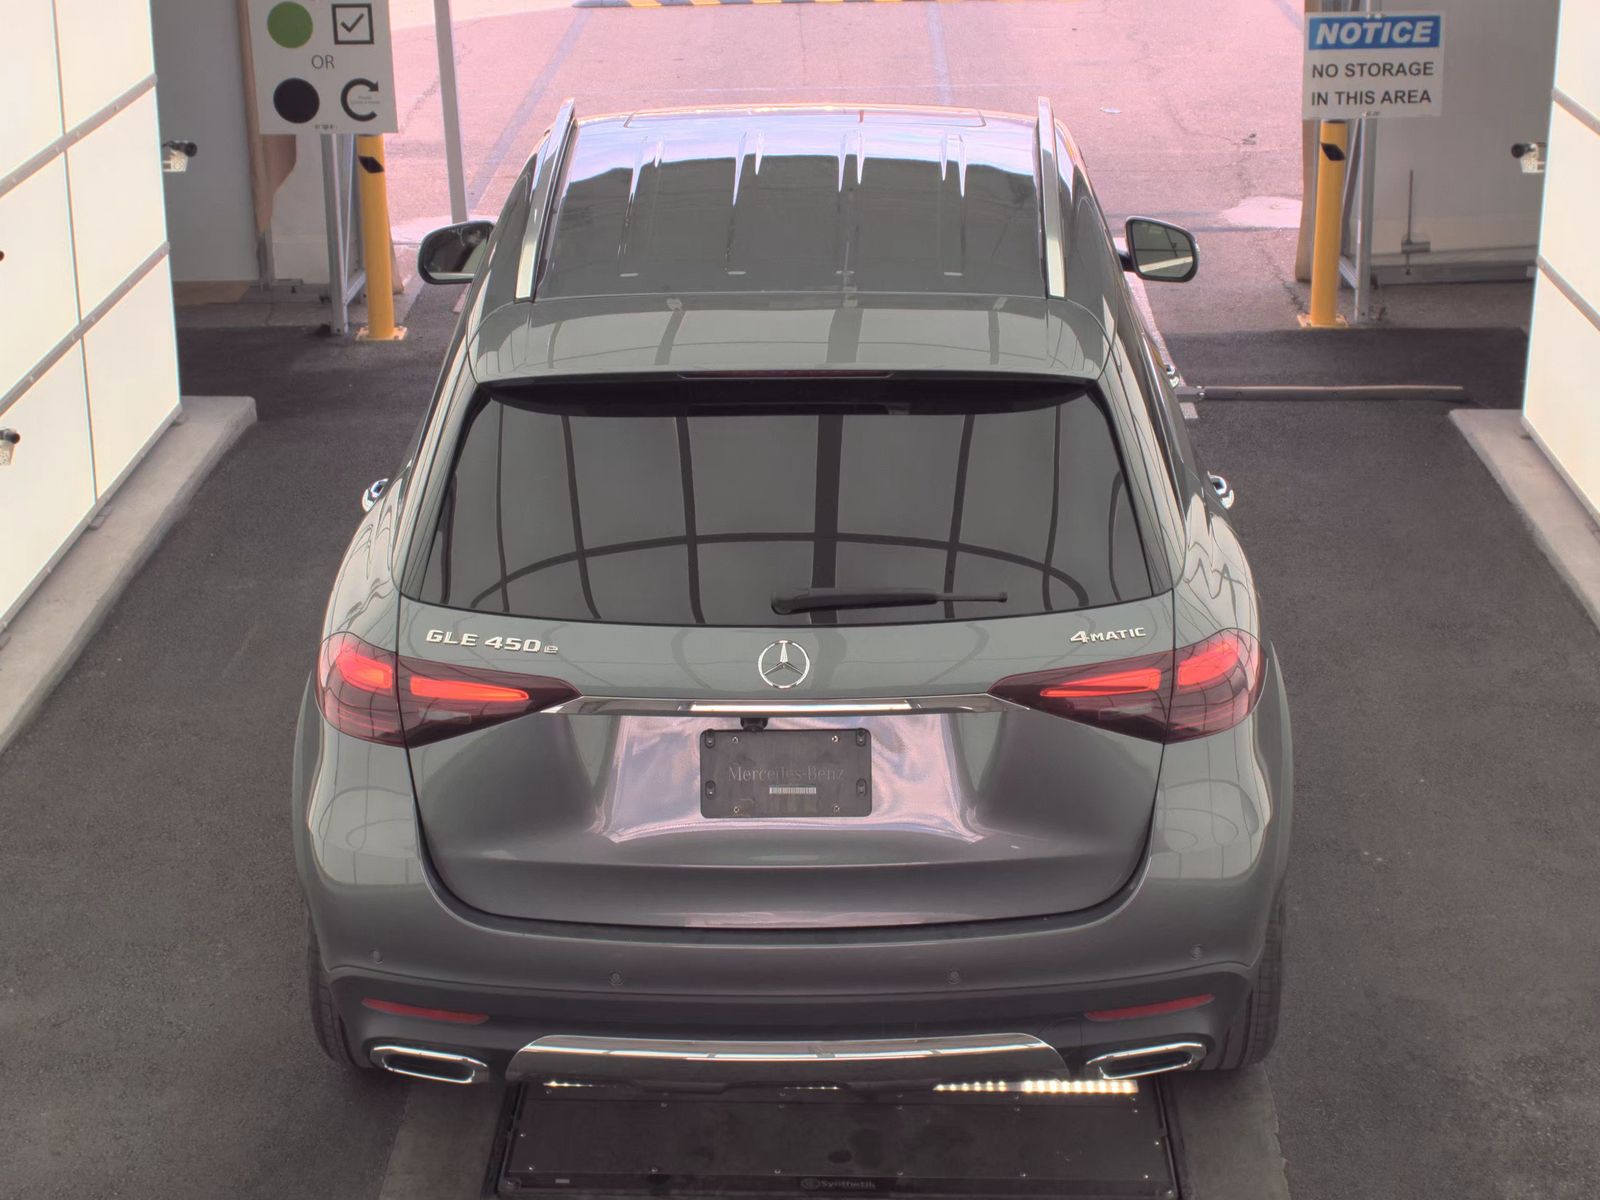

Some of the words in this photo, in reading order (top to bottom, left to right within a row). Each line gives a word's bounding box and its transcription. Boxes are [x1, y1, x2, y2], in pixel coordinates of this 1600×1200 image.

[1316, 21, 1434, 45] NOTICE
[311, 54, 335, 69] OR
[1312, 63, 1339, 78] NO
[1344, 61, 1434, 77] STORAGE
[1311, 91, 1329, 106] IN
[1335, 90, 1376, 105] THIS
[1380, 89, 1432, 104] AREA
[425, 628, 480, 647] GLE
[1070, 627, 1147, 644] 4MATIC
[728, 765, 845, 782] Mercedes-Benz
